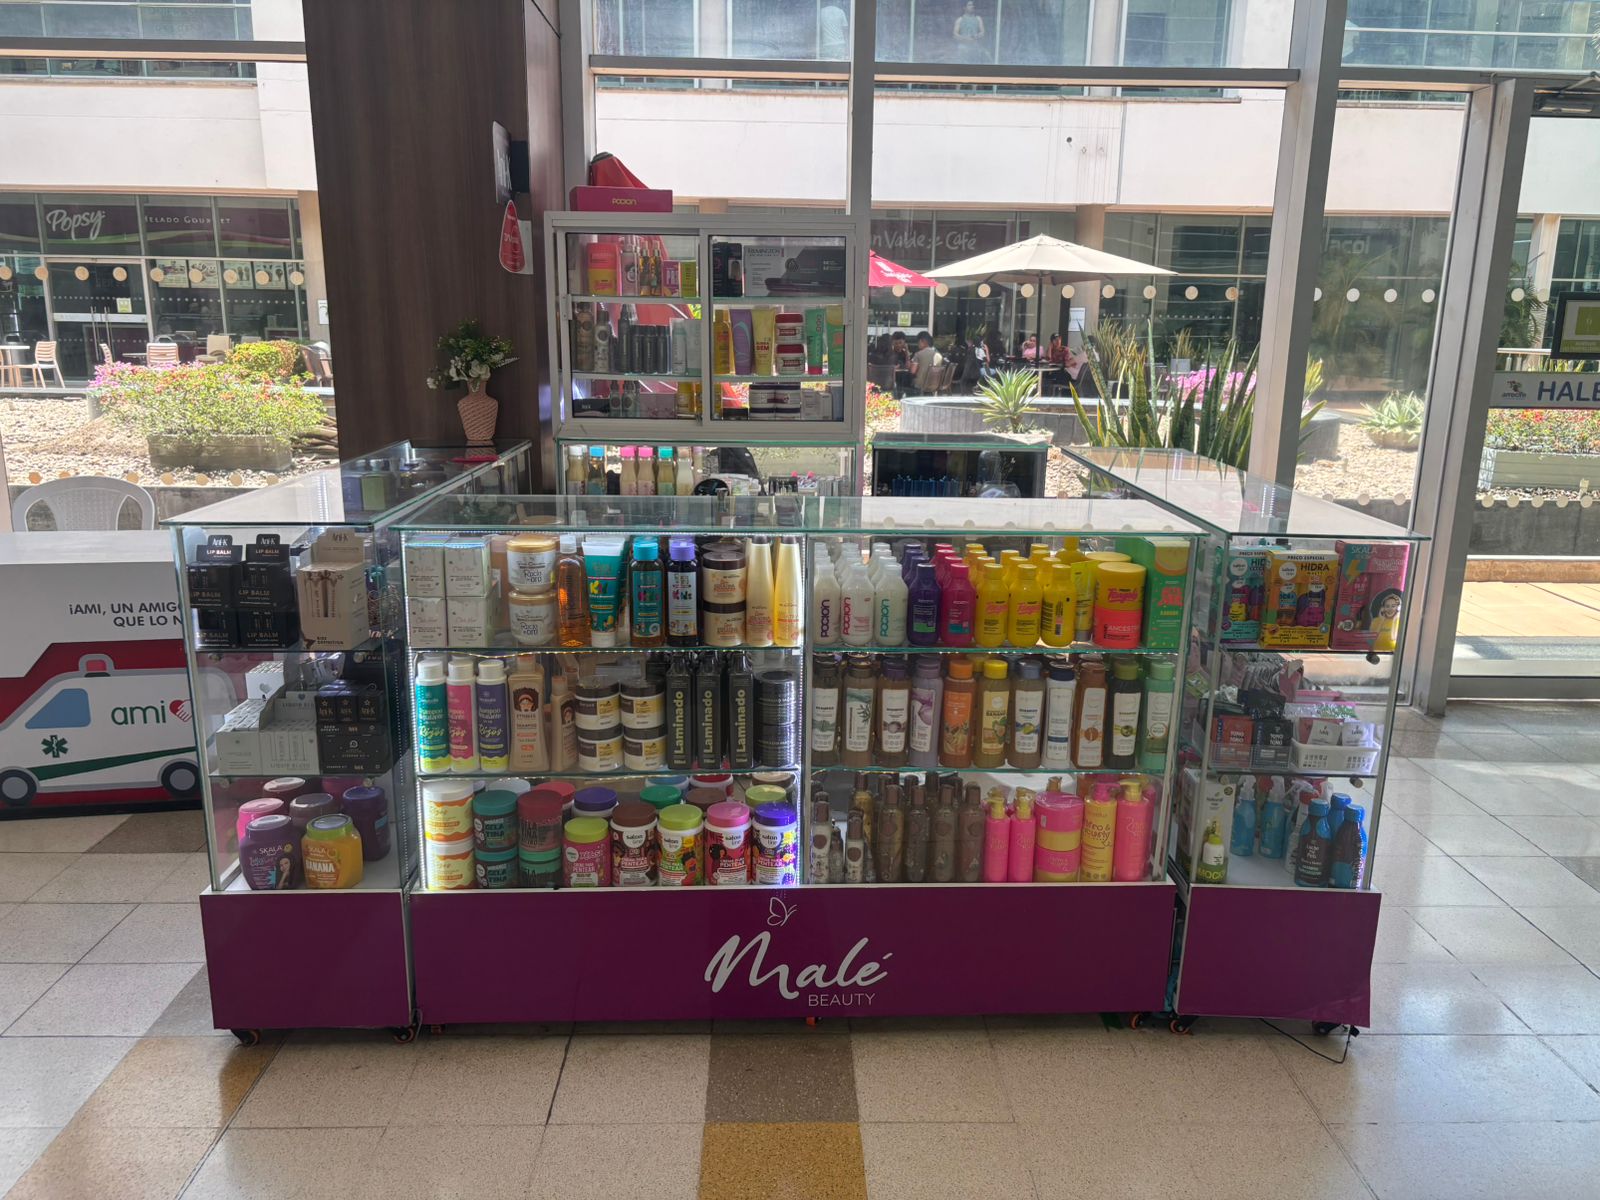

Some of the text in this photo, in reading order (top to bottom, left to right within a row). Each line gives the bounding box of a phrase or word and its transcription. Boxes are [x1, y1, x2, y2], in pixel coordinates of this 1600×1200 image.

[46, 208, 104, 240] Popsy
[945, 231, 977, 250] Café
[1300, 562, 1329, 572] HIDRA
[111, 603, 134, 614] UN
[113, 615, 145, 628] QUE
[150, 615, 168, 626] LO
[110, 700, 167, 726] ami
[702, 690, 713, 753] Laminado
[735, 689, 746, 753] Laminado
[479, 724, 502, 738] Rizos
[673, 691, 684, 754] Laminado
[259, 844, 283, 855] SKALA
[305, 859, 335, 873] BANANA
[704, 930, 893, 1000] Malé
[808, 992, 876, 1007] BEAUTY
